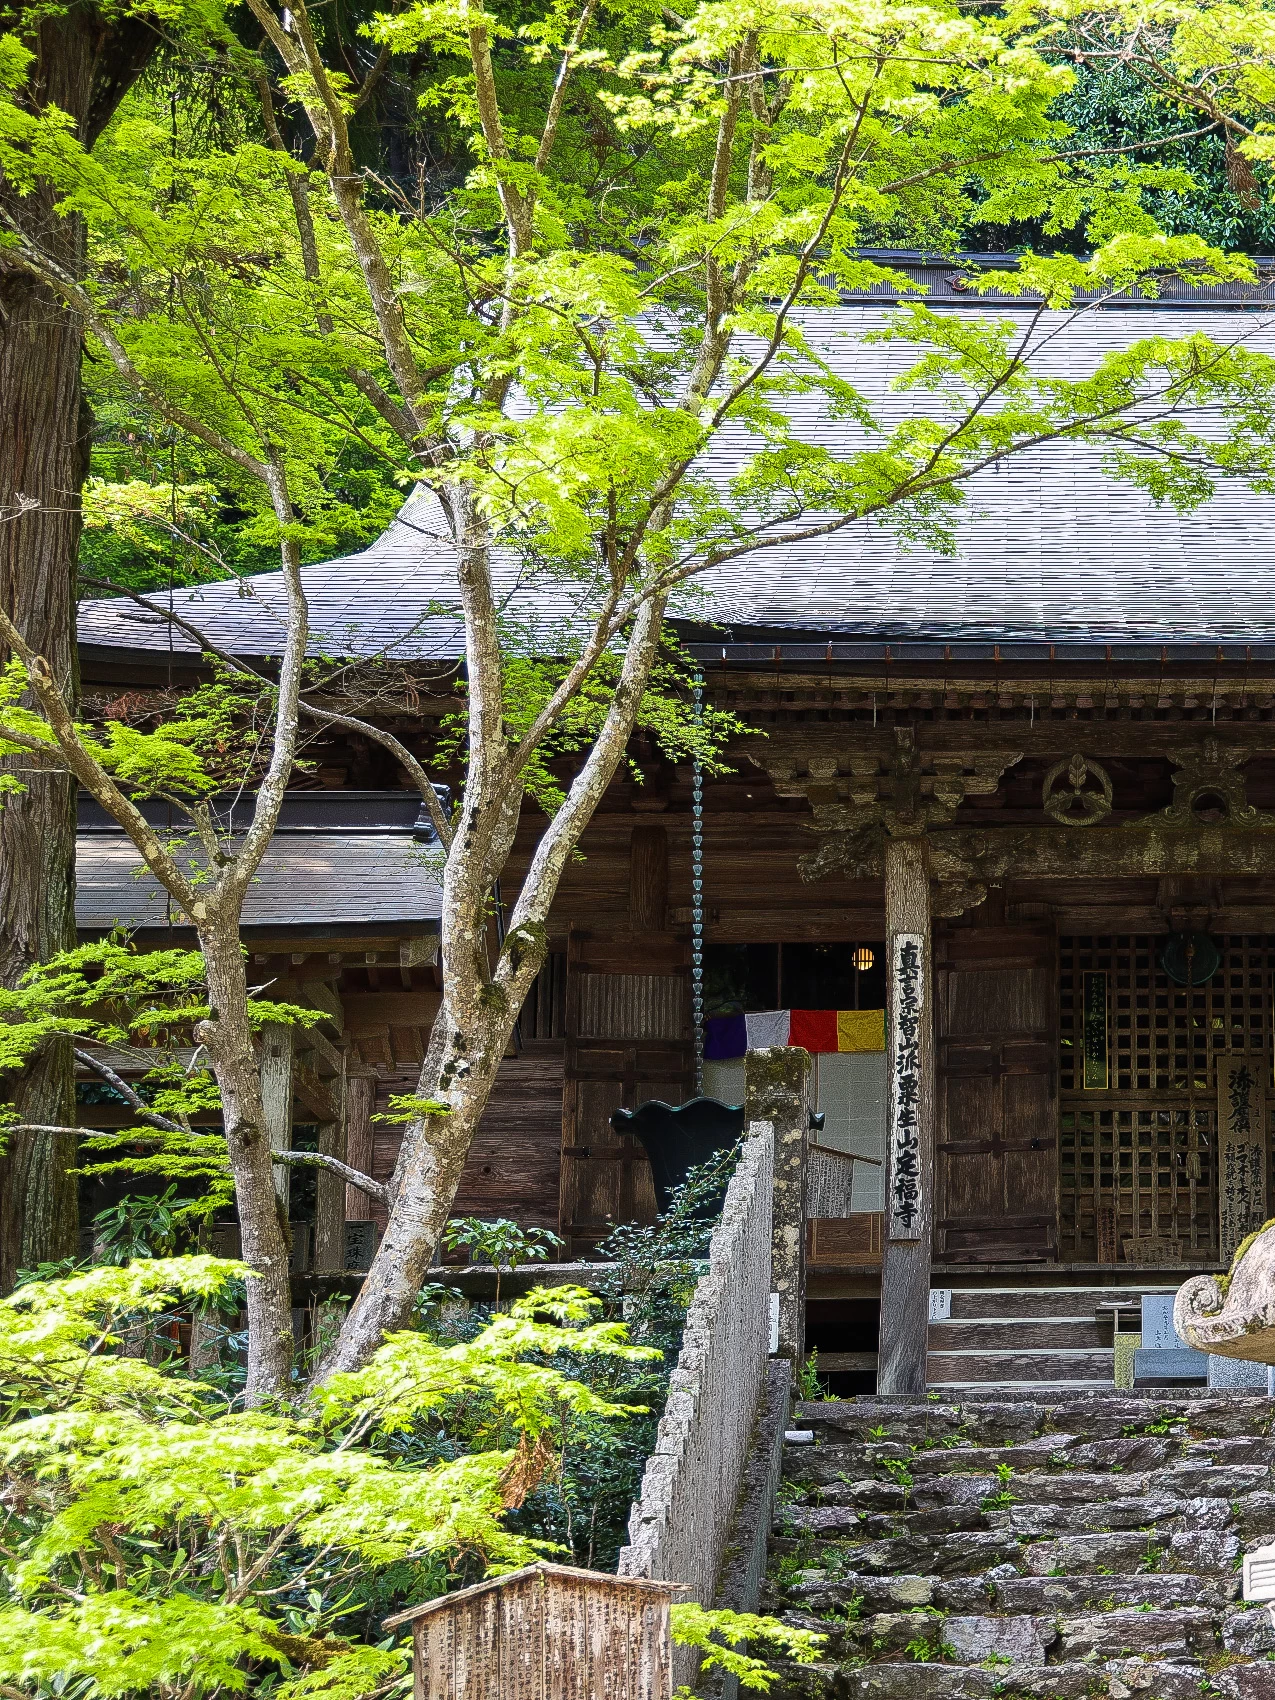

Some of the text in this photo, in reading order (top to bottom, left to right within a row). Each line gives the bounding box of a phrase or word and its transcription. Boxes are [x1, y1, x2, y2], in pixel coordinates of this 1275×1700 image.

[893, 940, 922, 1229] 真言宗智山派粟生山定福寺
